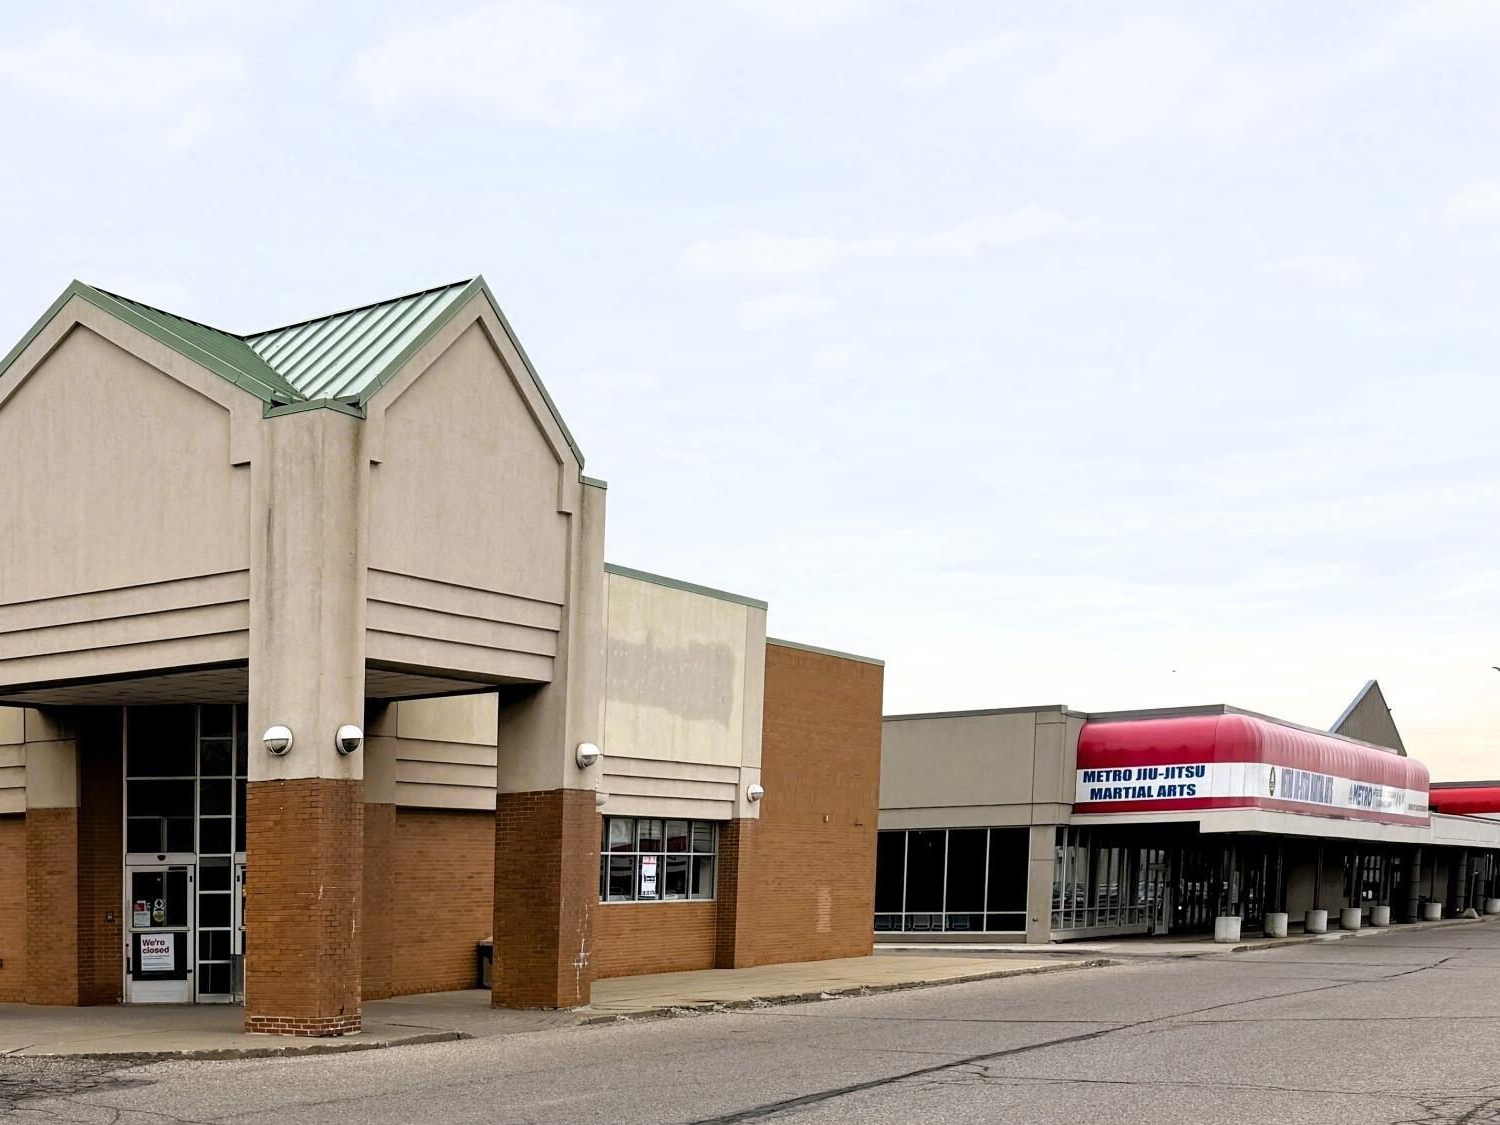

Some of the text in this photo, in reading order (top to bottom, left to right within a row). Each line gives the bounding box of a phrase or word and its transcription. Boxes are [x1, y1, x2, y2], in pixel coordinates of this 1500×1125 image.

[1083, 765, 1206, 783] METRO JIU-JITSU
[1090, 784, 1197, 800] MARTIAL ARTS
[142, 946, 170, 954] closed
